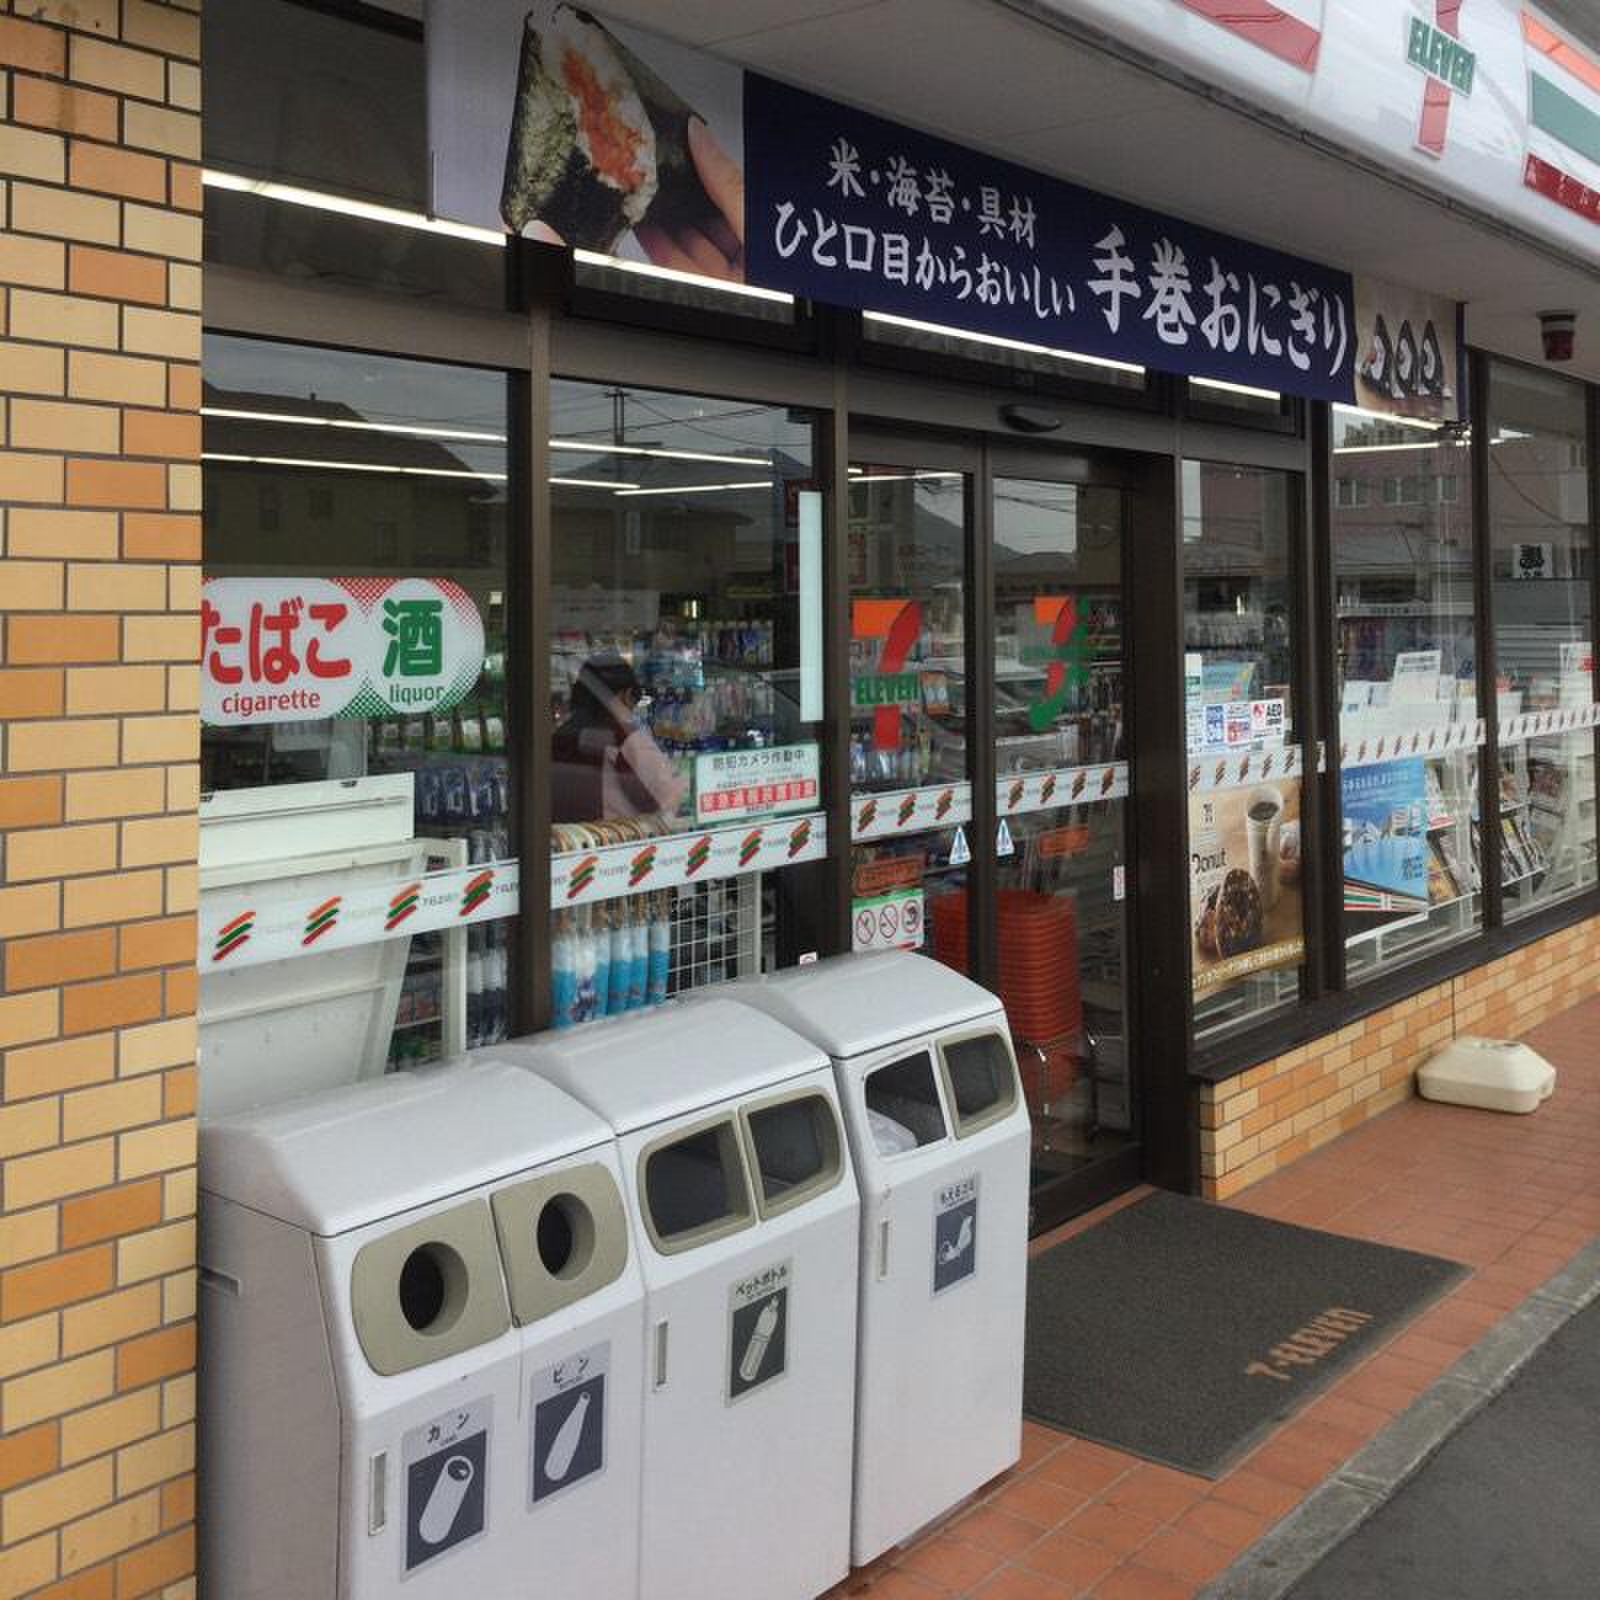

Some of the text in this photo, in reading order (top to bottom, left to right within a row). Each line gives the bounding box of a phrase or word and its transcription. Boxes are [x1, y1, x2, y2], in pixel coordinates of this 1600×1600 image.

[826, 137, 1038, 248] 米・海苔・具材
[773, 201, 1077, 321] ひと口目からおいしい
[1087, 224, 1350, 378] 手巻おにぎり
[201, 595, 352, 685] たばこ
[381, 598, 443, 678] 酒
[221, 688, 321, 717] cigarette
[389, 683, 446, 707] liquor
[857, 675, 919, 705] ELEVEN
[427, 1412, 470, 1444] カン
